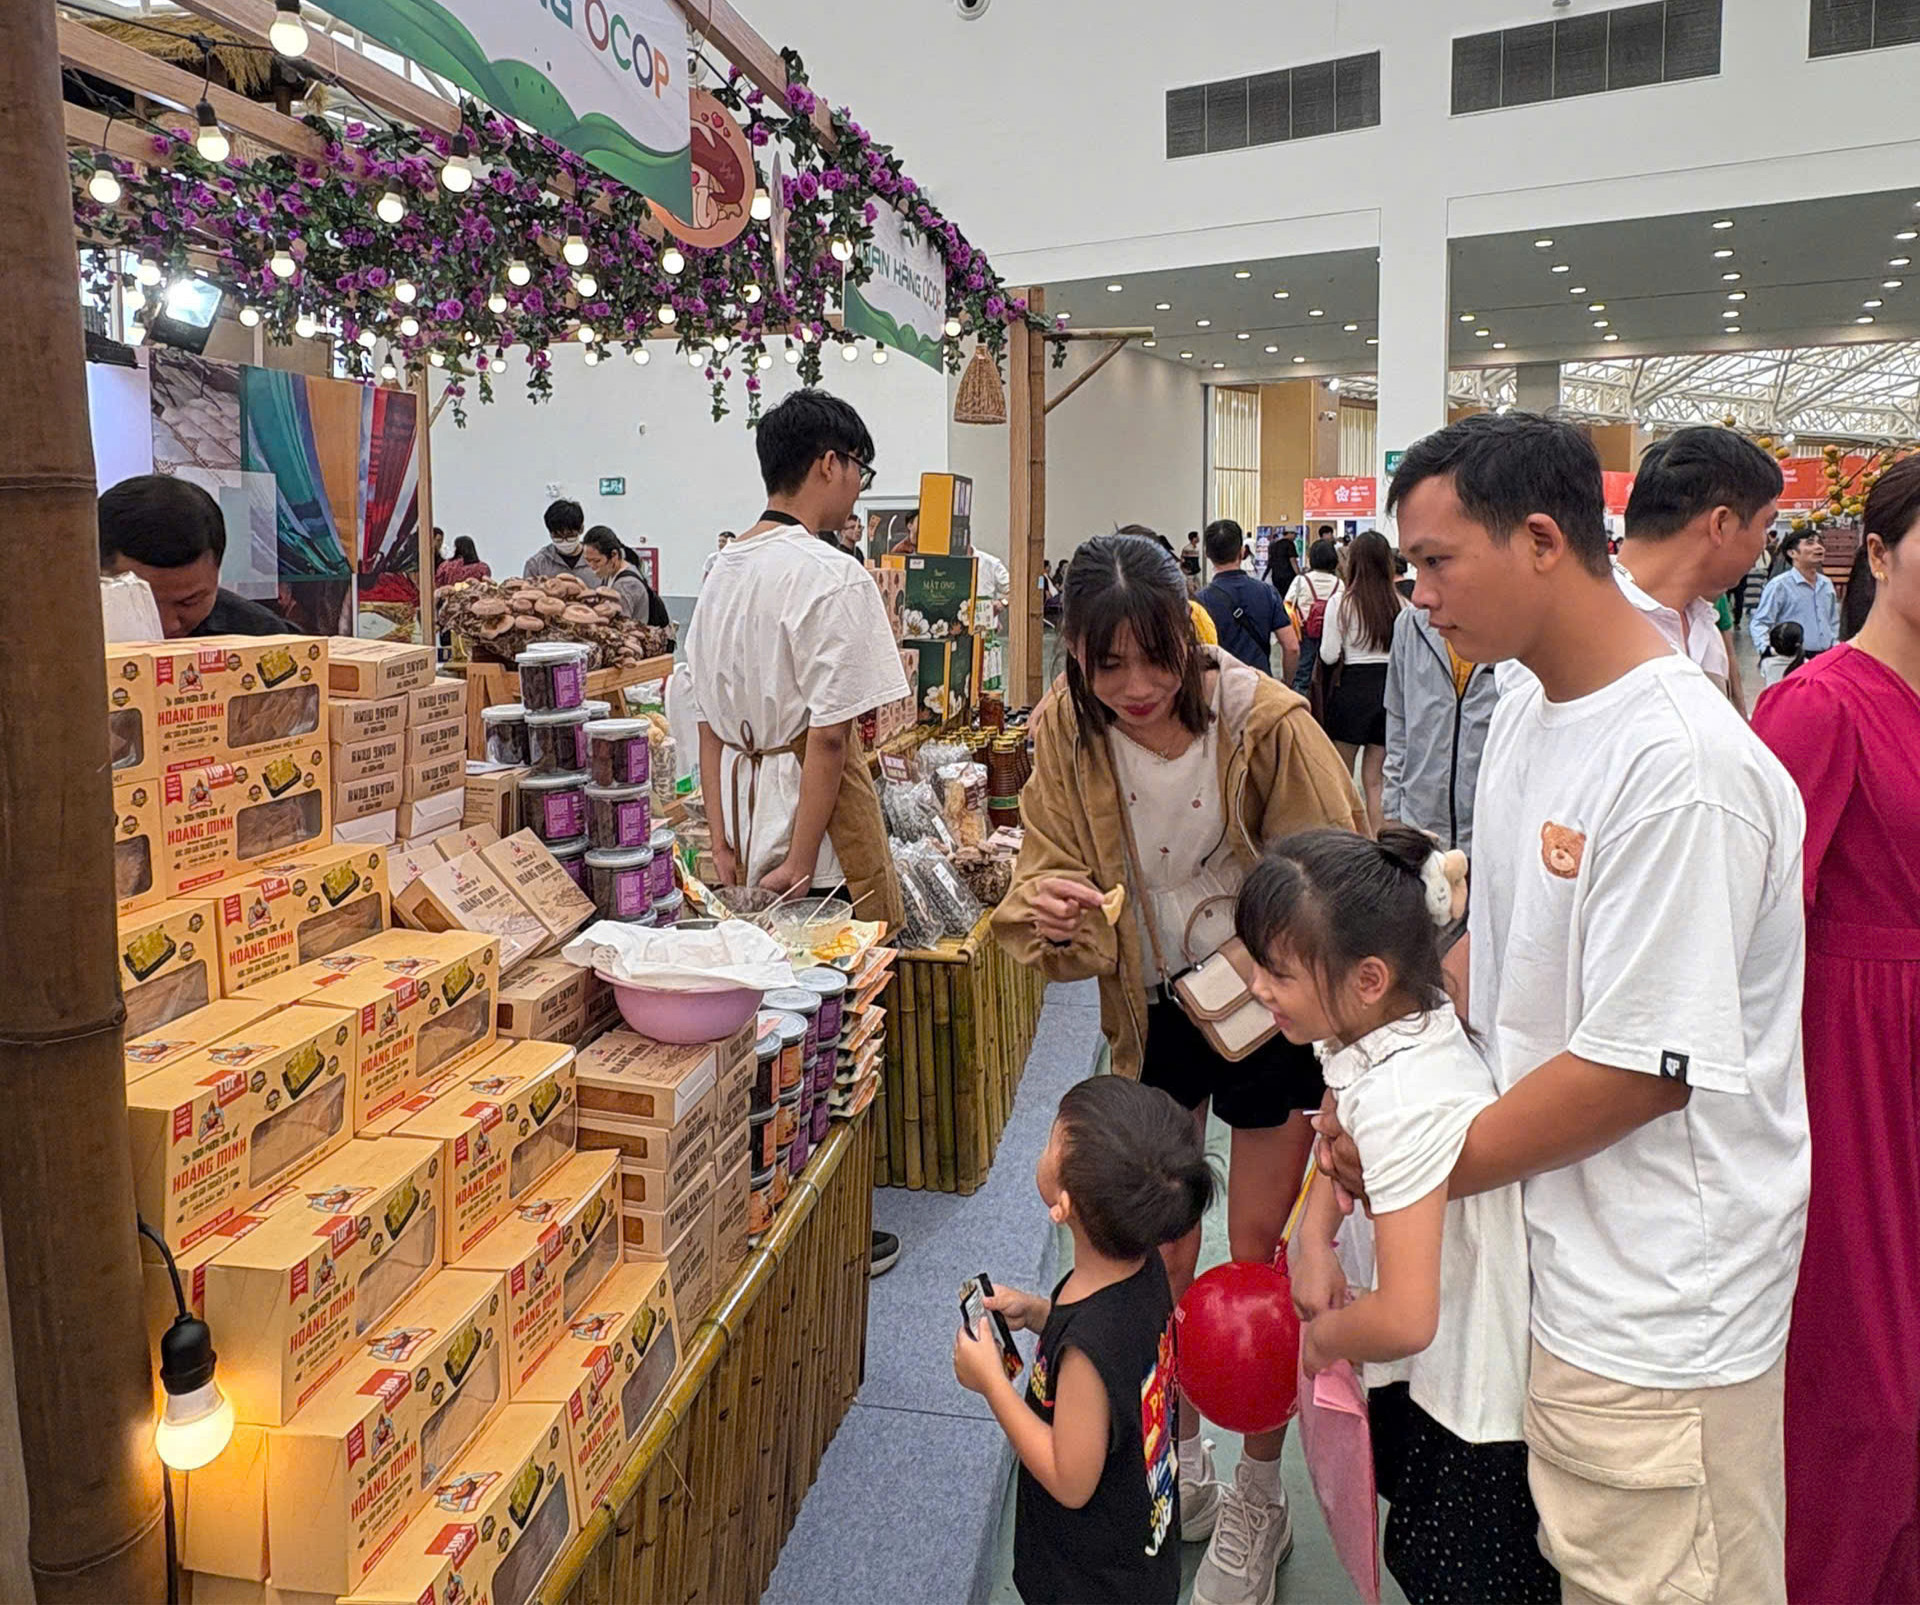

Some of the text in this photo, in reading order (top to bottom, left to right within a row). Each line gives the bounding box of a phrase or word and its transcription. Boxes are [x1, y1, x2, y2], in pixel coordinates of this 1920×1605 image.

[585, 0, 669, 99] OCOP
[893, 257, 921, 299] HÀNG
[390, 1440, 418, 1474] MINH
